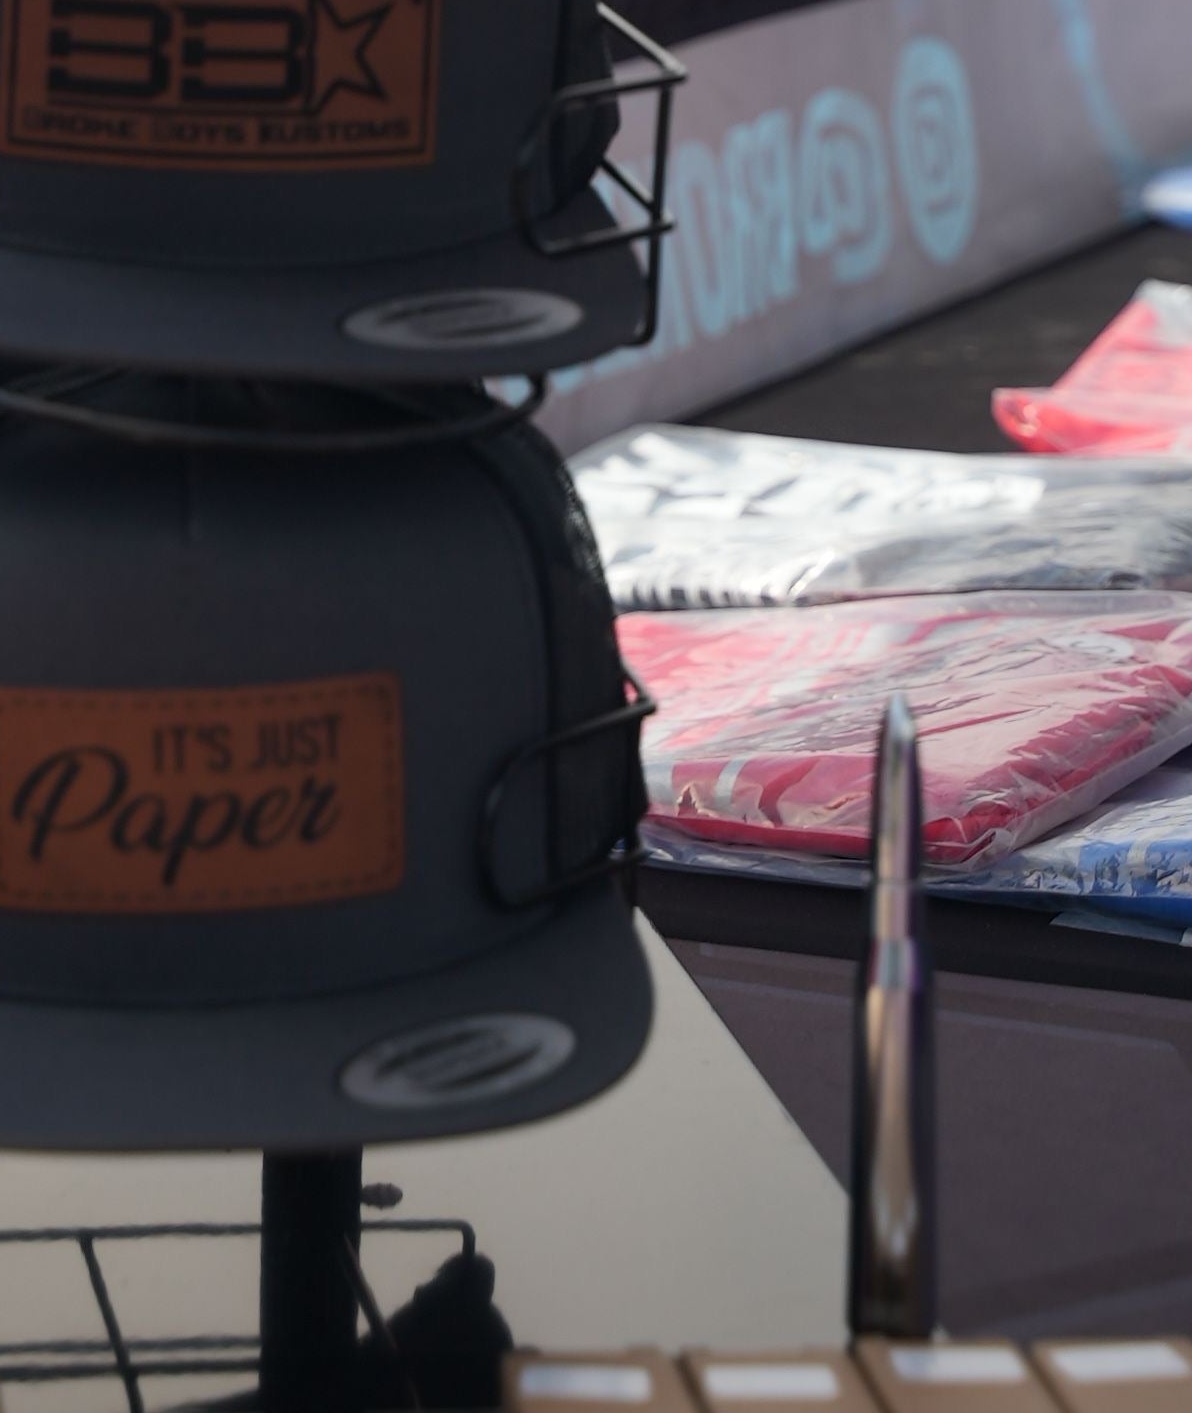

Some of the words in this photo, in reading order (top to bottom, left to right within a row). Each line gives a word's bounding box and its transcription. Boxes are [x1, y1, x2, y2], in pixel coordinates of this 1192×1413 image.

[152, 723, 233, 774] IT'S
[252, 713, 344, 770] JUST
[13, 745, 340, 886] Paper
